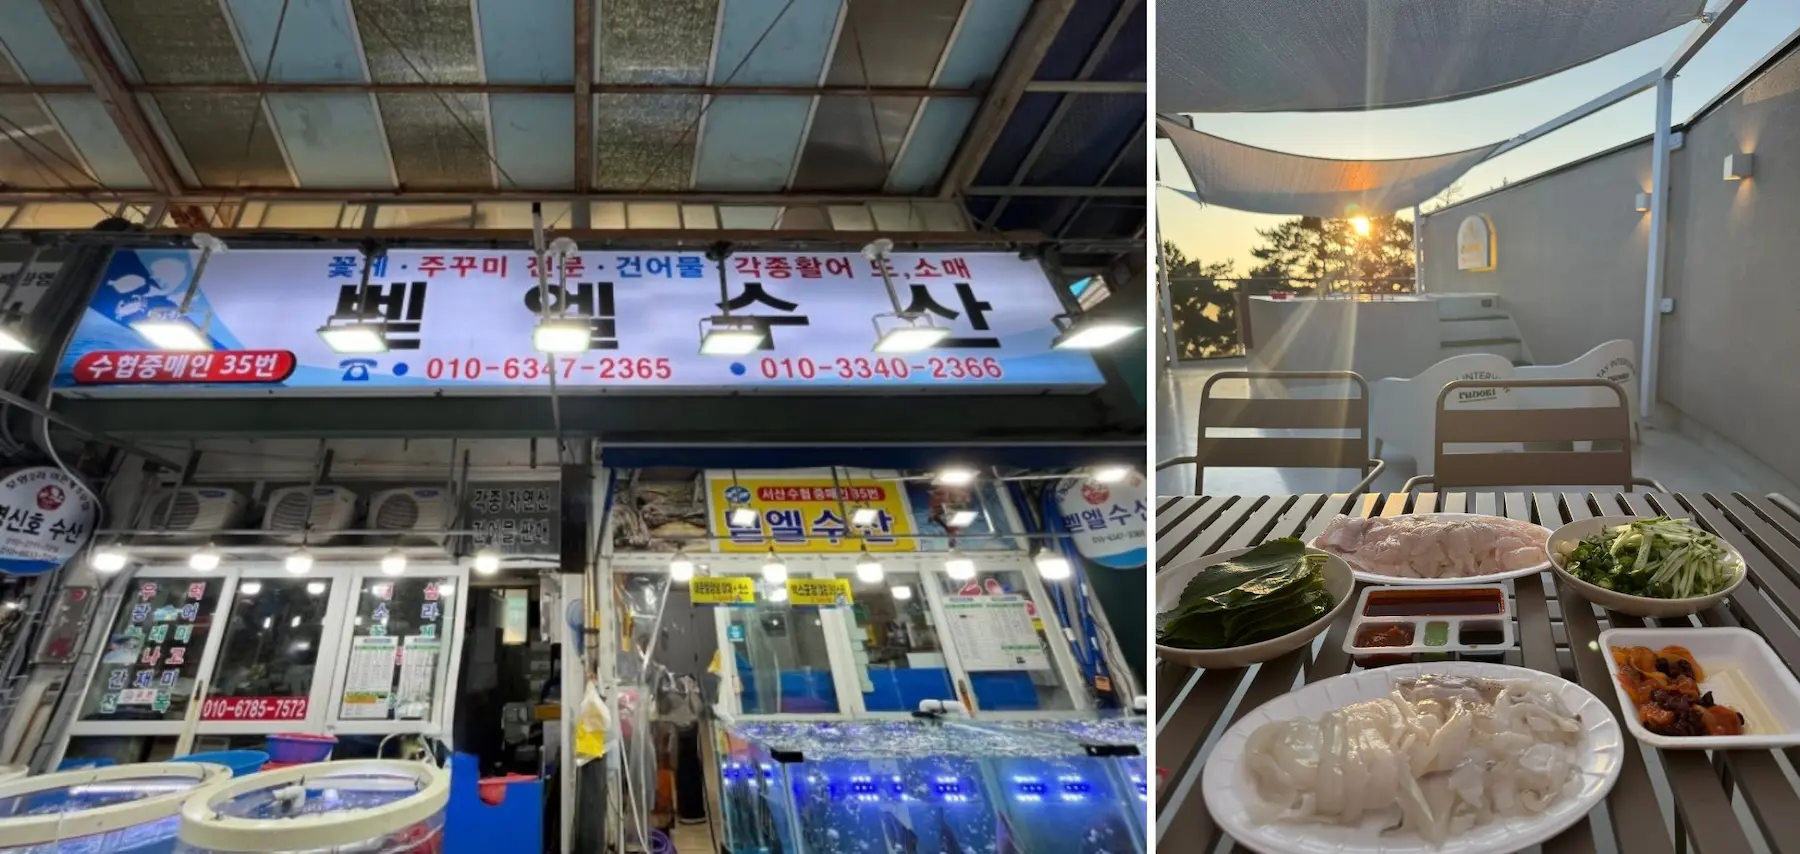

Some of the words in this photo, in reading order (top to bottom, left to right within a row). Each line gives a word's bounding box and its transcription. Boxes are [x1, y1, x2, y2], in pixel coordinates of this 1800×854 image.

[417, 255, 508, 279] 주꾸미
[526, 256, 586, 279] 전문
[616, 256, 704, 279] 건어물
[734, 256, 854, 279] 각종활어
[88, 353, 215, 379] 수협중매인
[220, 353, 278, 378] 35번
[426, 358, 673, 380] 010-6347-2365
[760, 356, 1002, 380] 010-3340-2366
[475, 489, 501, 513] 각종
[506, 489, 550, 513] 자연산
[49, 518, 84, 544] 수산
[108, 668, 180, 691] 간재미
[203, 698, 306, 719] 010-6785-7572
